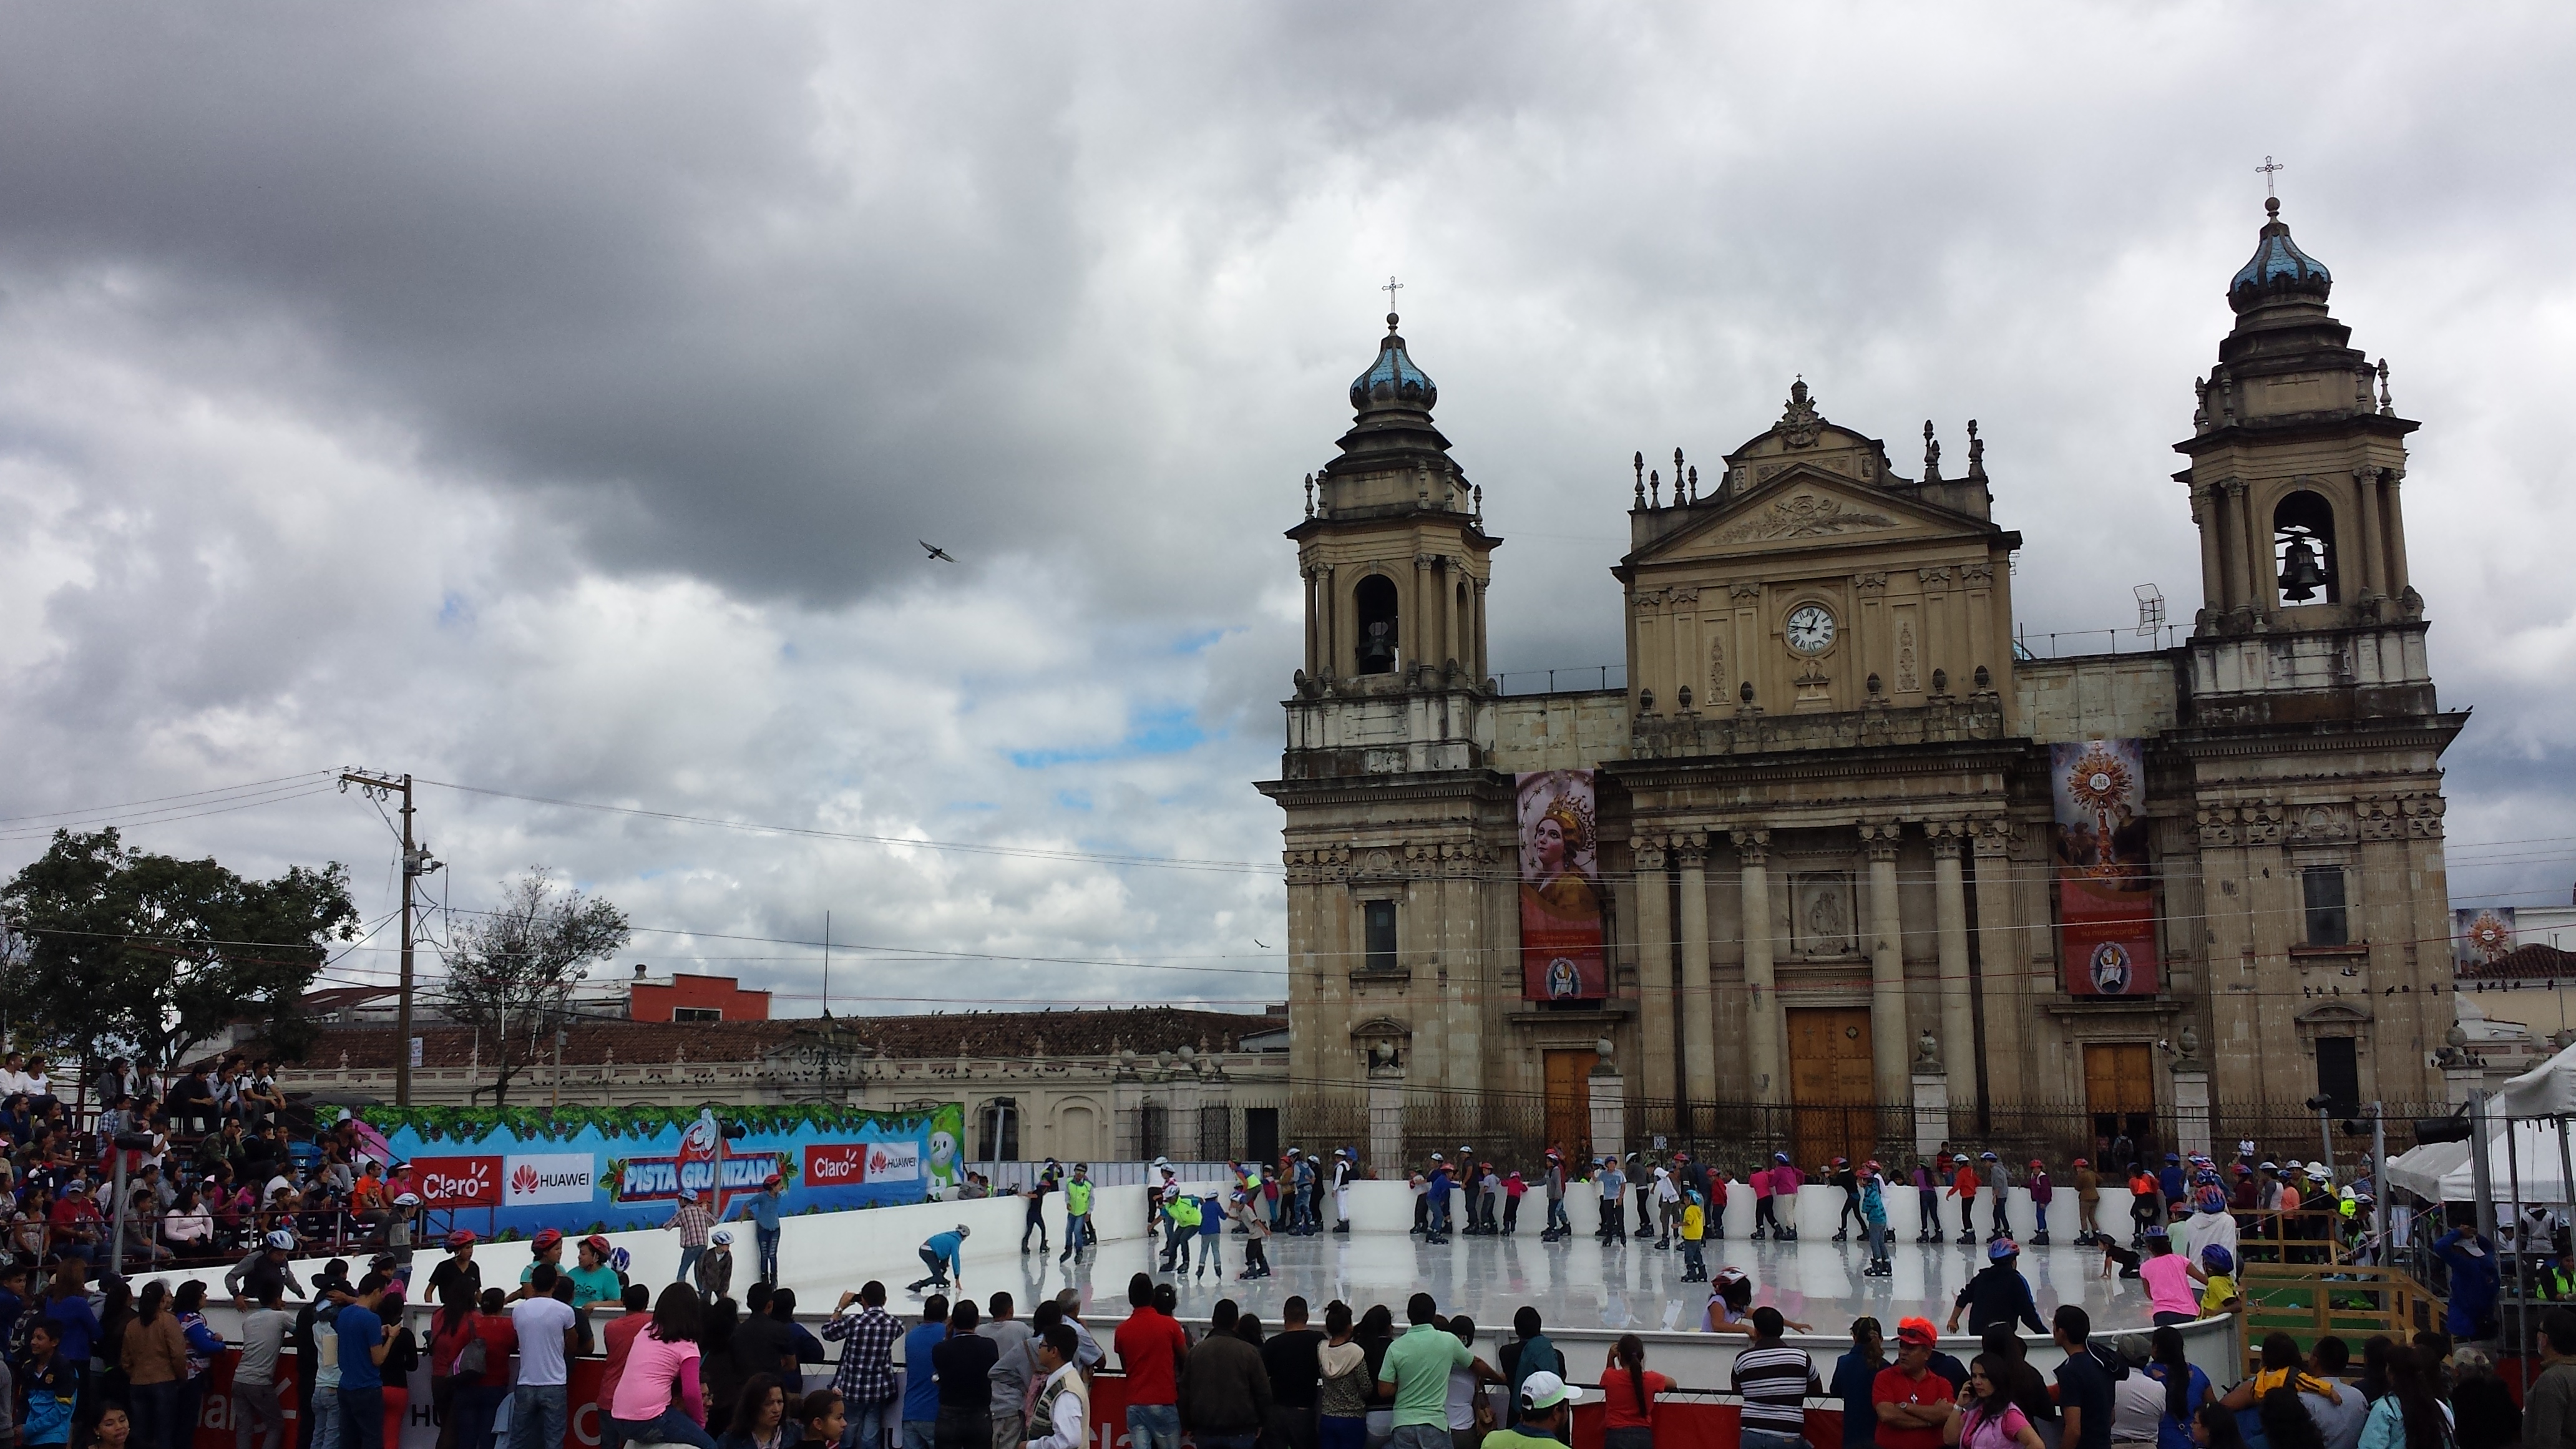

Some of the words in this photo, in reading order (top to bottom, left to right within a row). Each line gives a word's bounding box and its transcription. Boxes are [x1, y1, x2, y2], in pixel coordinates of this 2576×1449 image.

[814, 1157, 849, 1178] Claro
[887, 1157, 916, 1169] HUAWEI
[423, 1173, 479, 1199] Claro
[540, 1173, 589, 1188] HUAWEI
[623, 1163, 678, 1194] PISTA
